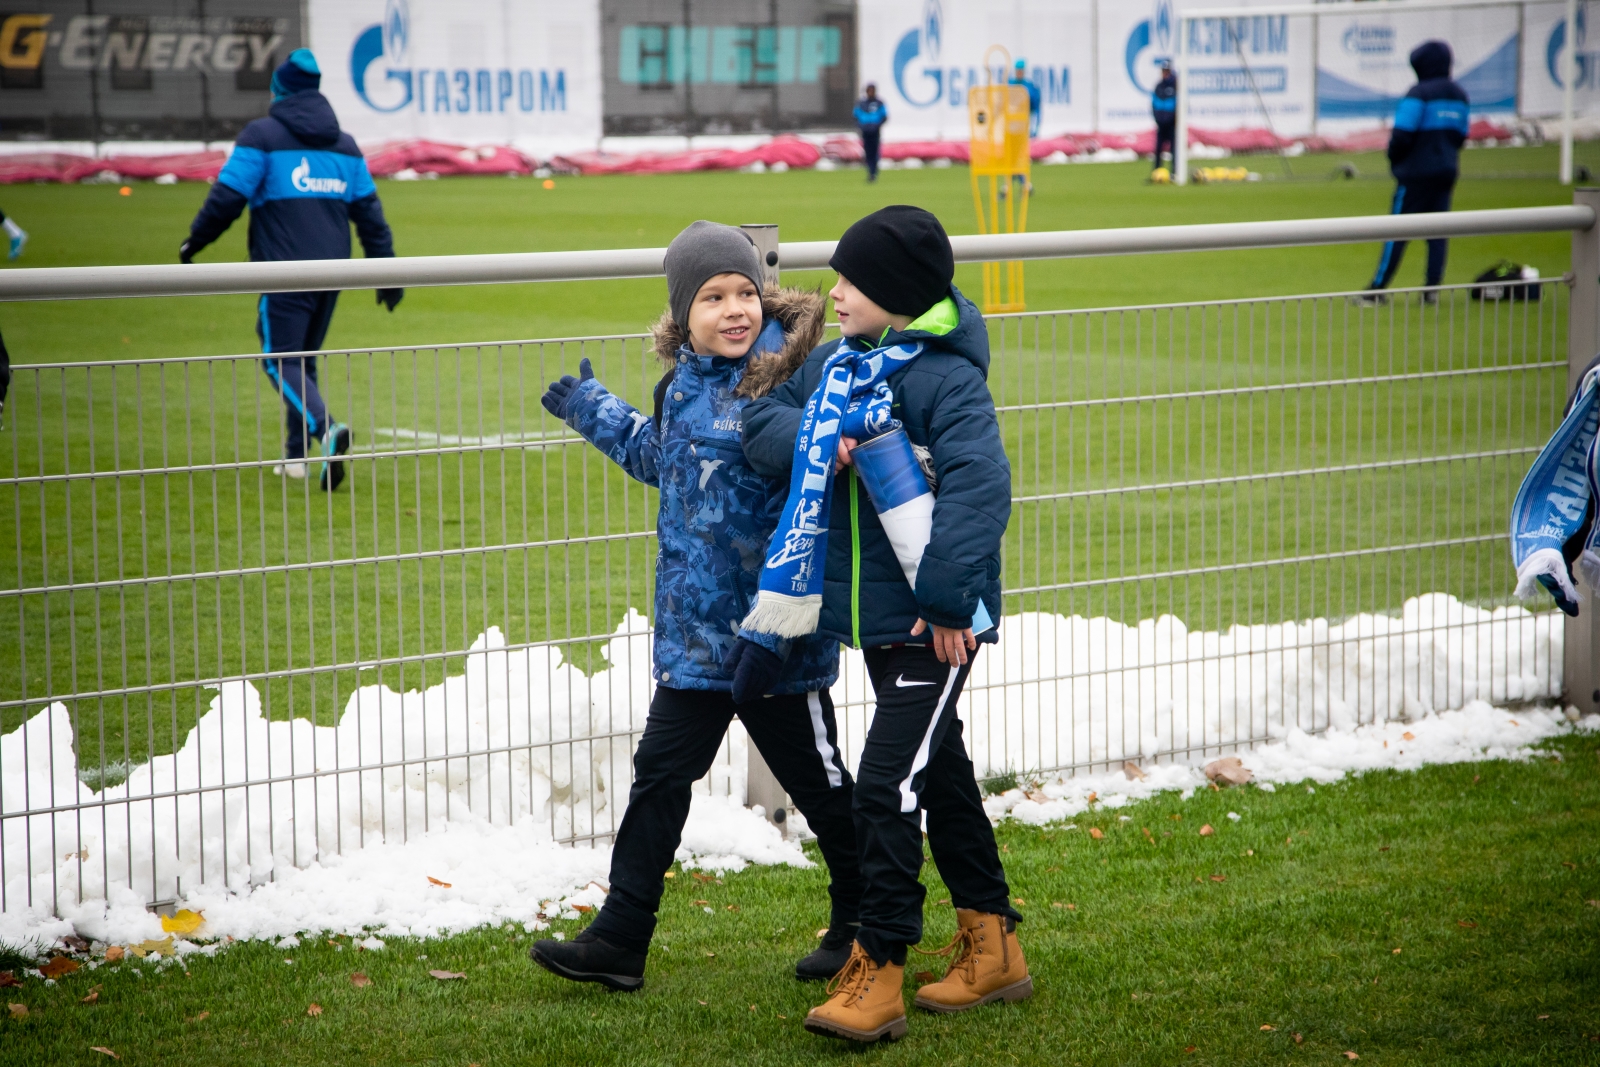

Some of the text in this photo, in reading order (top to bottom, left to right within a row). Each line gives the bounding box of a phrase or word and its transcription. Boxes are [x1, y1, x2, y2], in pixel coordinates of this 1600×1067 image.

[619, 26, 843, 84] СИБУР
[417, 69, 567, 114] ГАЗПРОМ
[798, 399, 817, 452] 26 МАЯ
